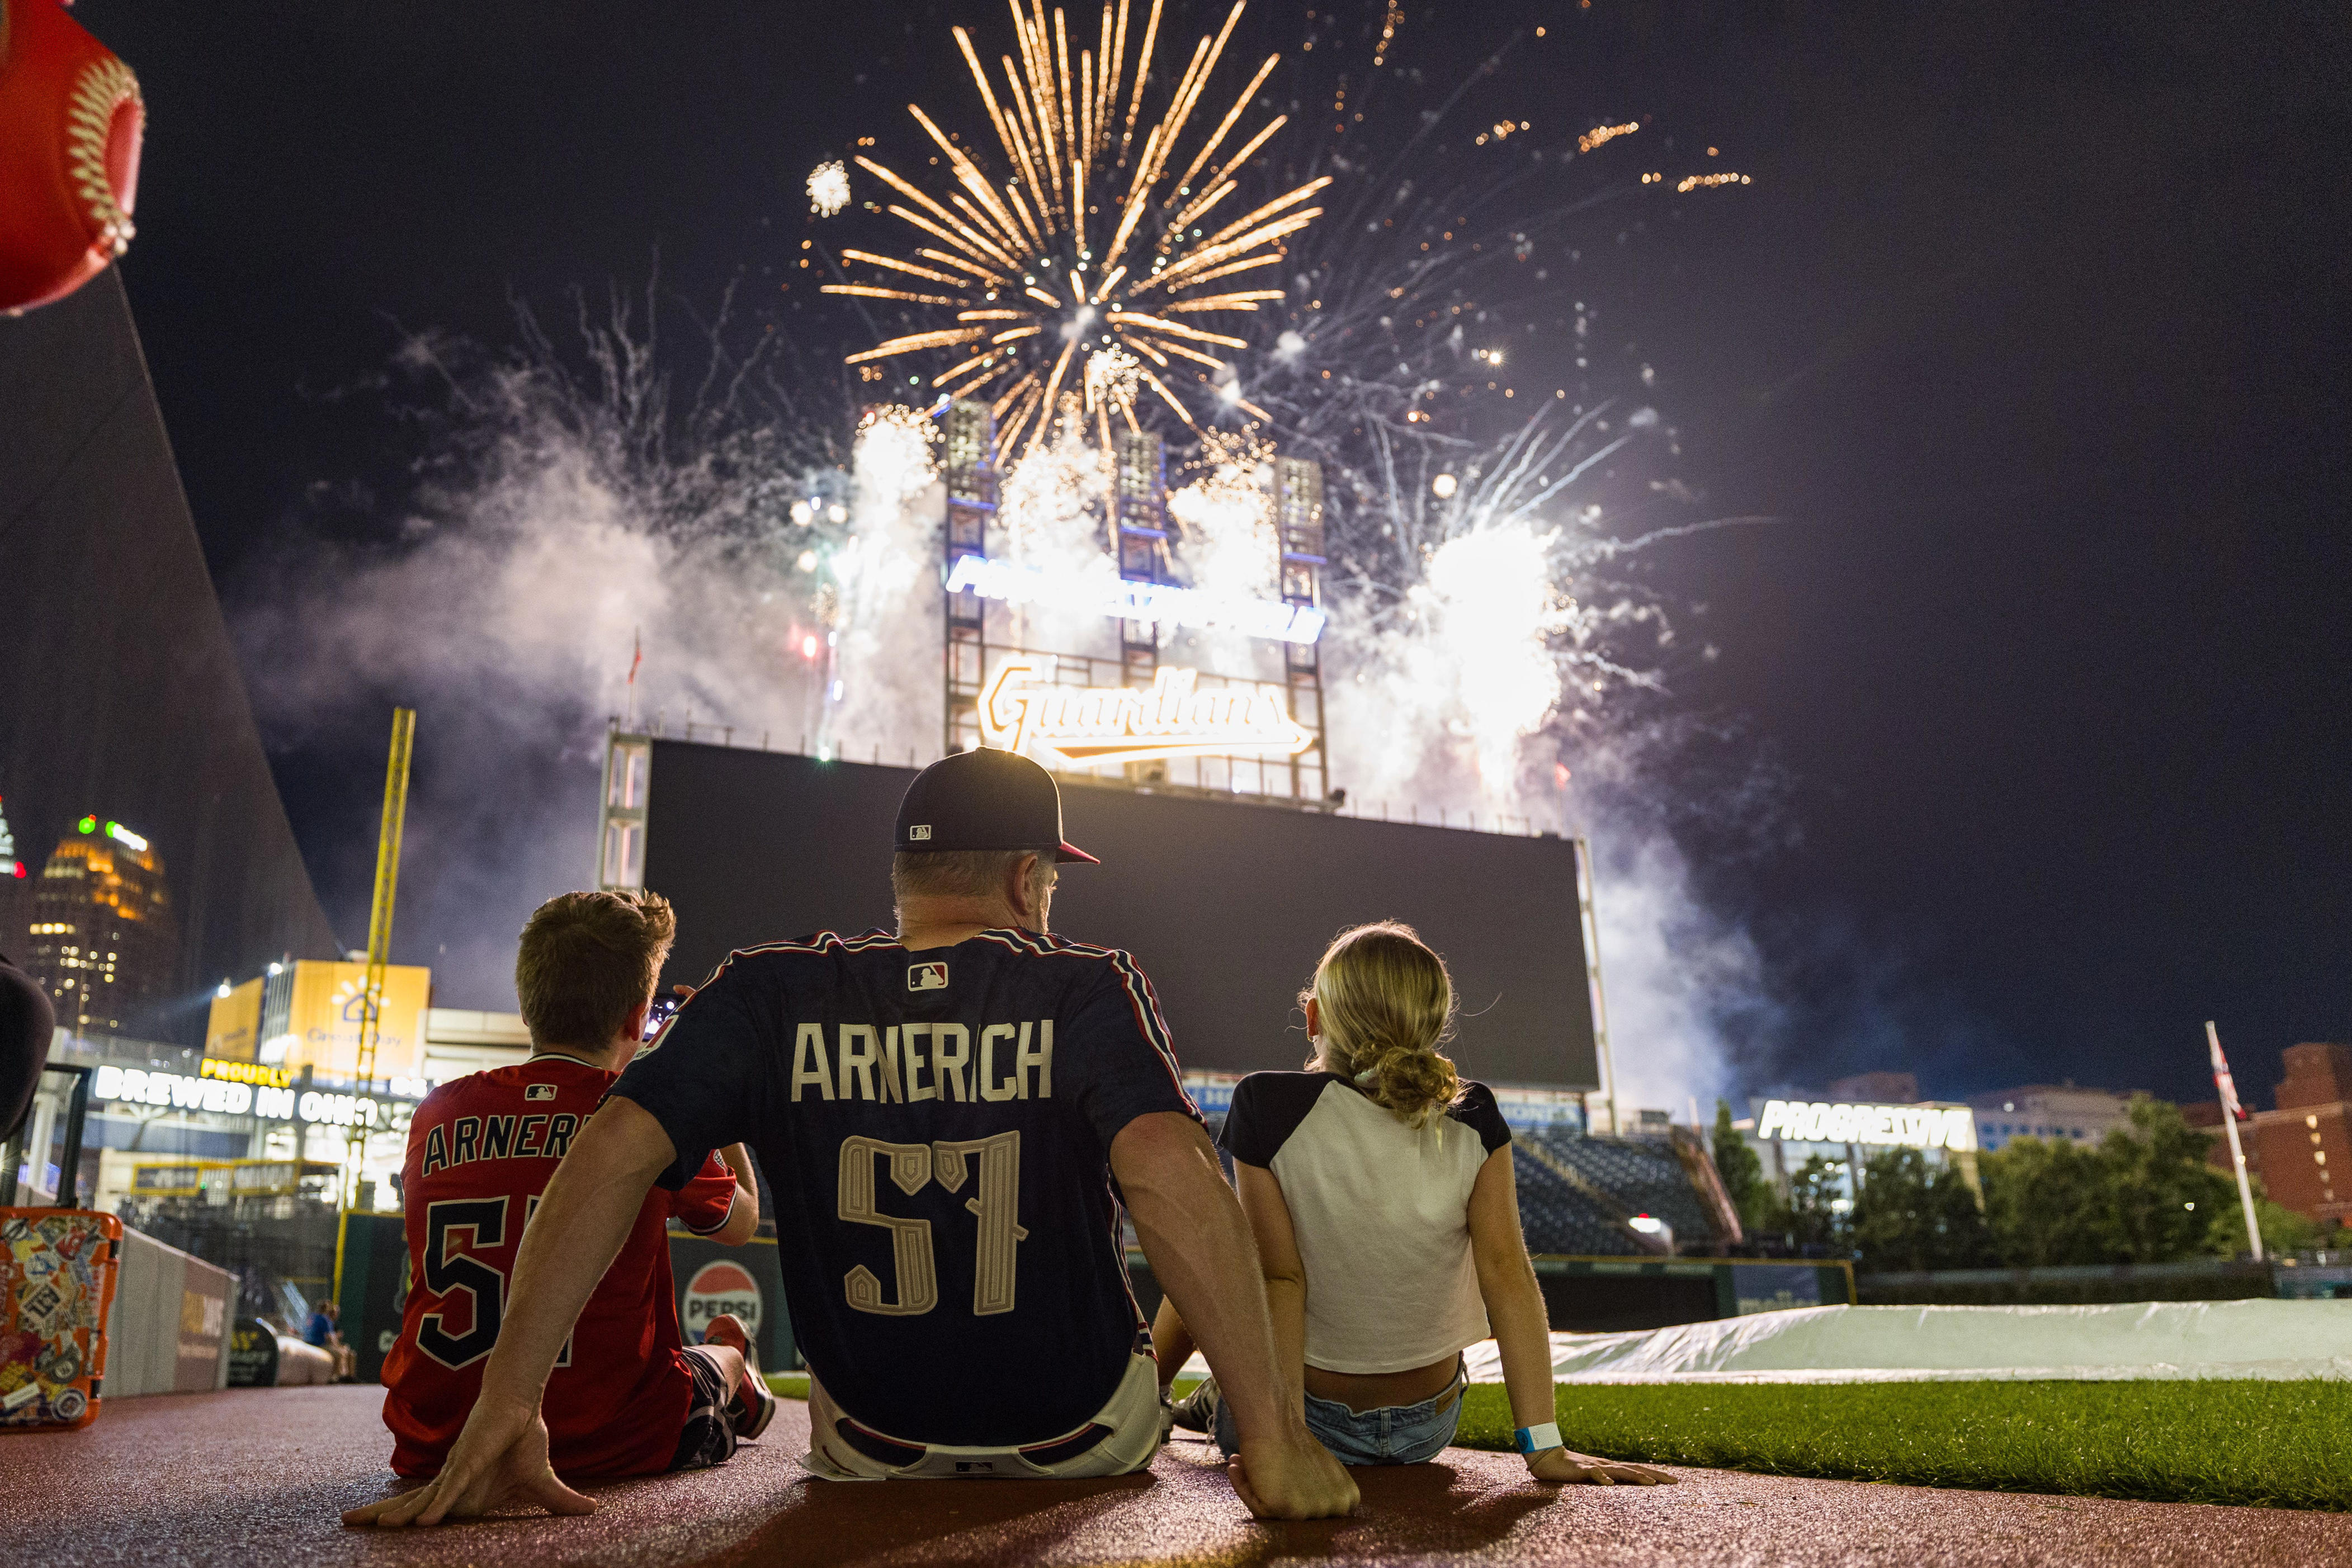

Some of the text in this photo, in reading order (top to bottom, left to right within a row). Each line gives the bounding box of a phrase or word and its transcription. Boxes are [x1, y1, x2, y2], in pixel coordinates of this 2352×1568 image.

[200, 1057, 292, 1088] PROUDLY
[791, 1019, 1054, 1104] ARNERICH
[95, 1065, 252, 1114] BREWED
[256, 1085, 295, 1120] IN
[422, 1113, 594, 1178] ARNER
[1758, 1099, 1972, 1150] PROGRESSIVE
[838, 1130, 1029, 1316] 57
[689, 1299, 756, 1320] PEPSI
